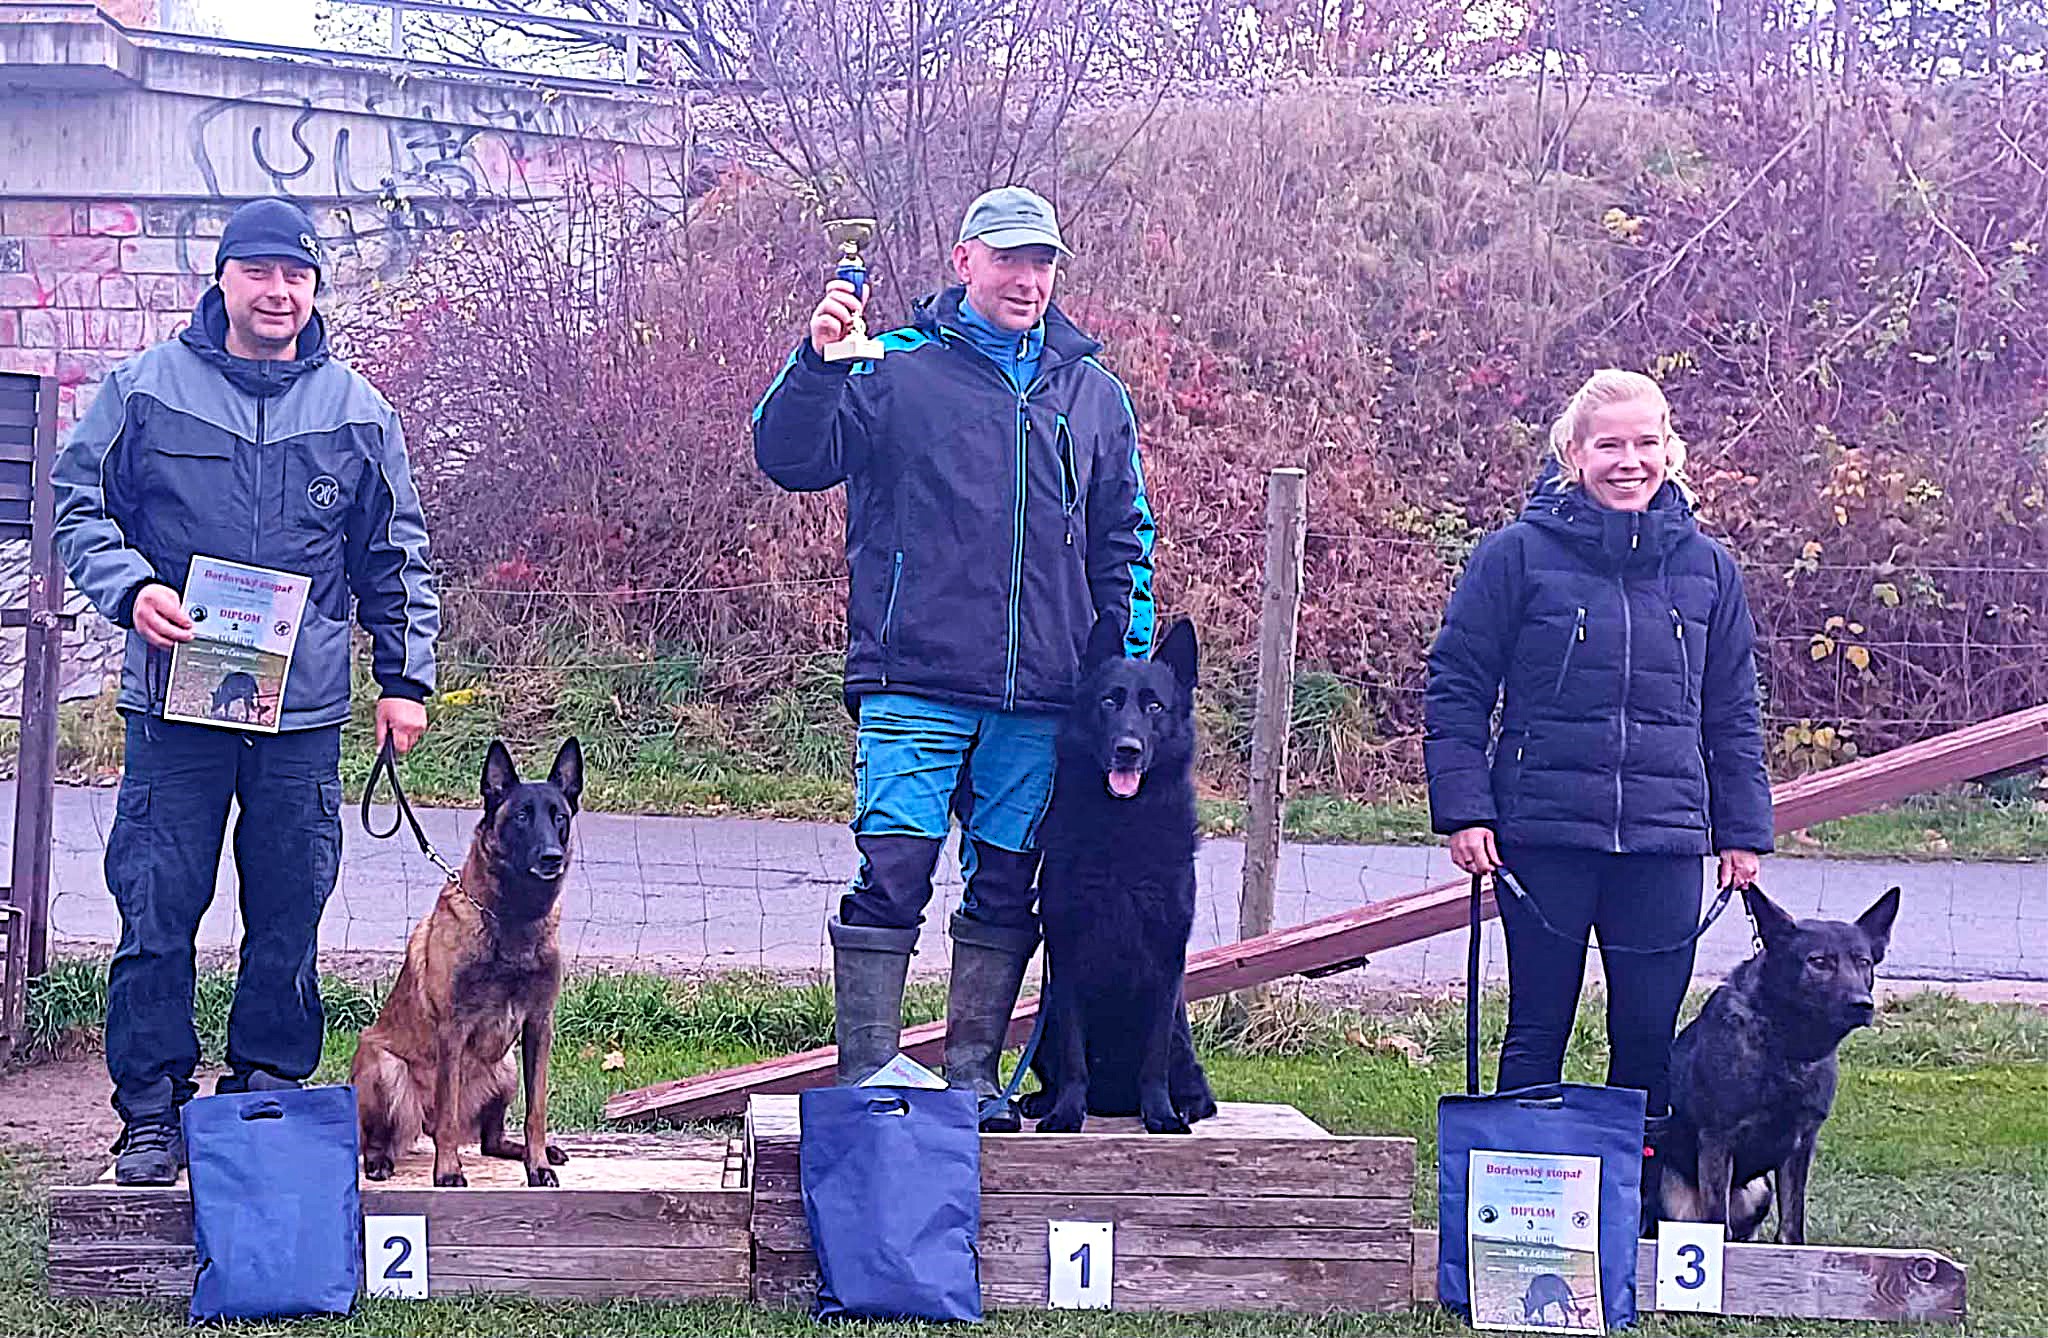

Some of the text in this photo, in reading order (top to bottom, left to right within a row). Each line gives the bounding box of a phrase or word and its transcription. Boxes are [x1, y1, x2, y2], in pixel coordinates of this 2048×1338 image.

[219, 608, 261, 624] DIPLOM
[231, 623, 239, 631] 2
[1510, 1206, 1556, 1218] DIPLOM
[1526, 1219, 1534, 1230] 3
[383, 1236, 413, 1279] 2
[1069, 1243, 1090, 1288] 1
[1675, 1244, 1706, 1289] 3
